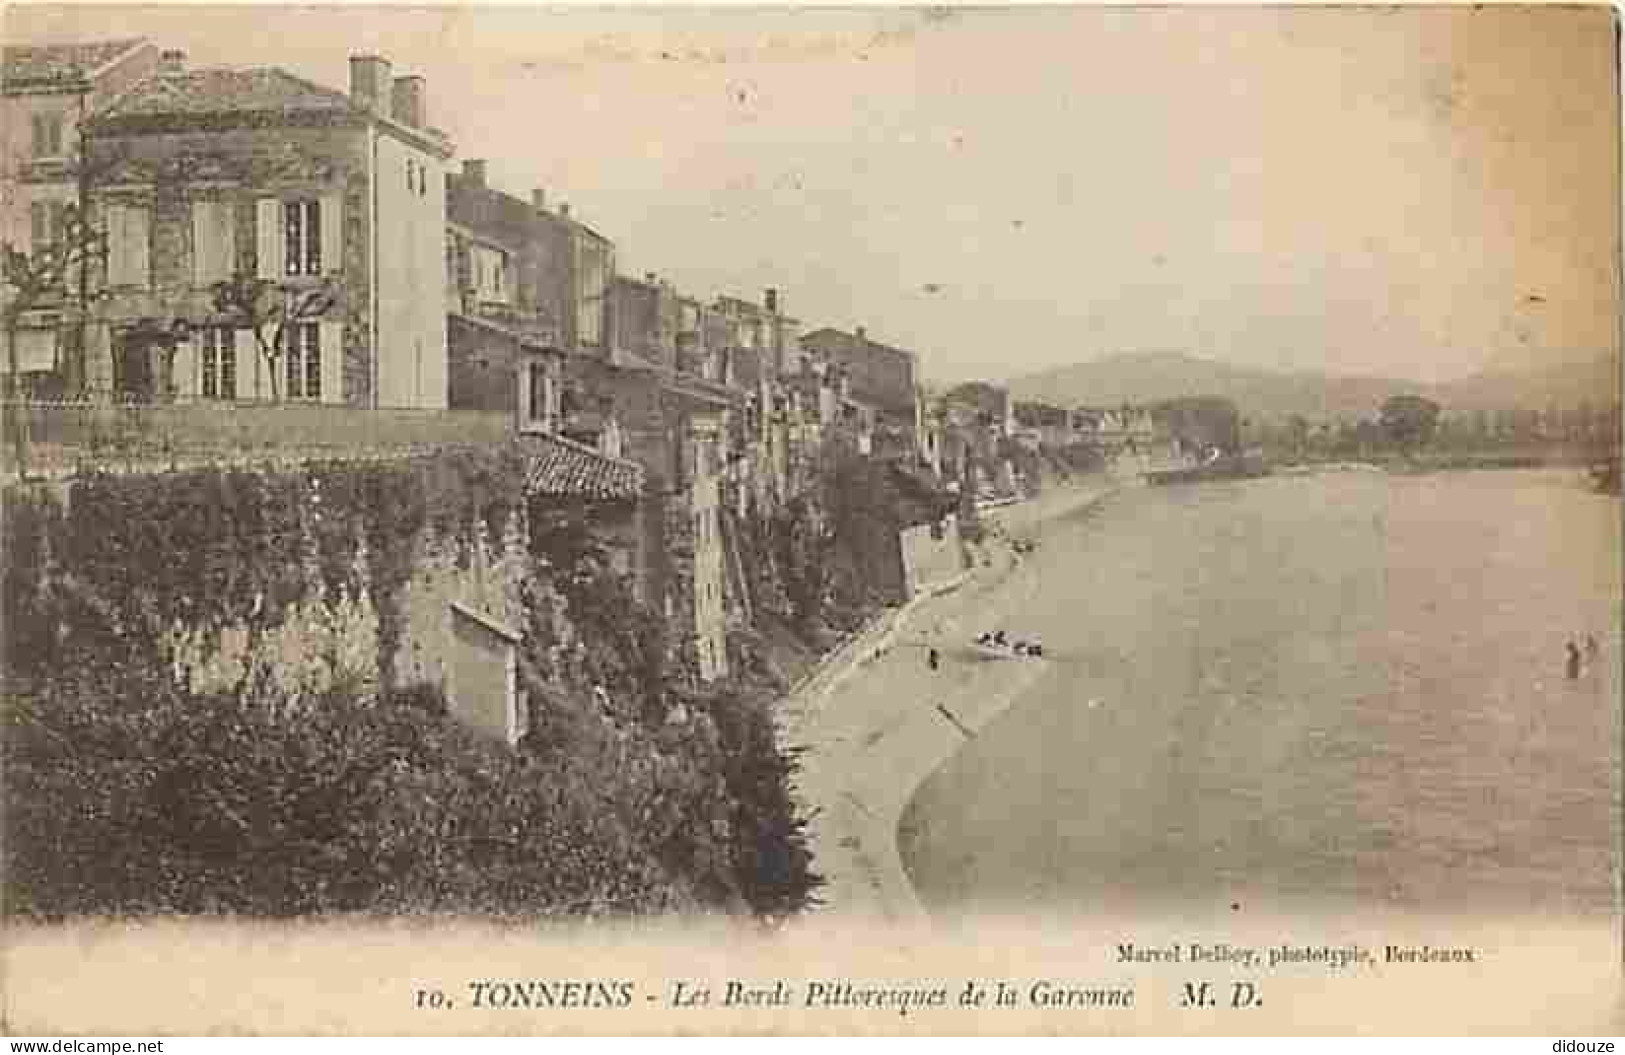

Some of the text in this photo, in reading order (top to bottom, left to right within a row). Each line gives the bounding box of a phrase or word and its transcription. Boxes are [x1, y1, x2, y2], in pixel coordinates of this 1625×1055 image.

[1385, 944, 1475, 963] Bordeaux
[469, 981, 634, 1008] TONNEINS
[672, 981, 711, 1007] Les
[724, 981, 791, 1007] Bords
[805, 981, 947, 1016] Pittoresques
[958, 981, 986, 1007] de
[995, 981, 1018, 1007] la
[1029, 981, 1134, 1008] Garonne
[1181, 982, 1217, 1008] M.
[1230, 982, 1264, 1008] D.
